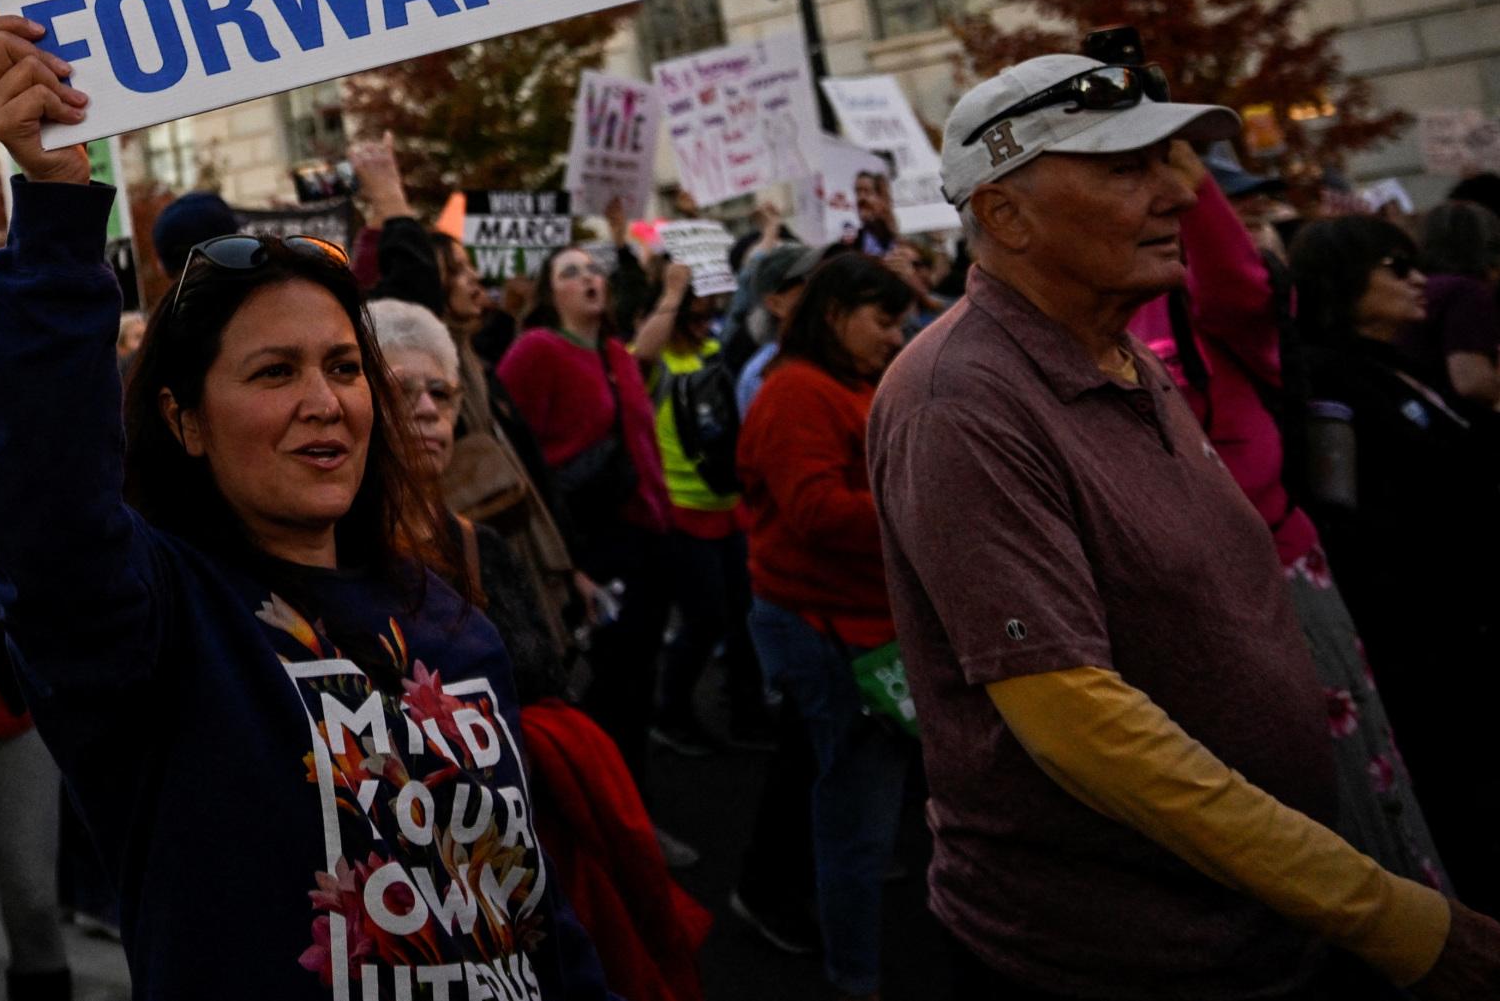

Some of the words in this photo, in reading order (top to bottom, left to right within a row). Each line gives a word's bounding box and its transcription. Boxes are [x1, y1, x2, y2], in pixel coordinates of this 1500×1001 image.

[982, 121, 1024, 168] H
[476, 219, 566, 245] MARCH
[340, 776, 534, 849] YOUR
[363, 861, 527, 937] OWN
